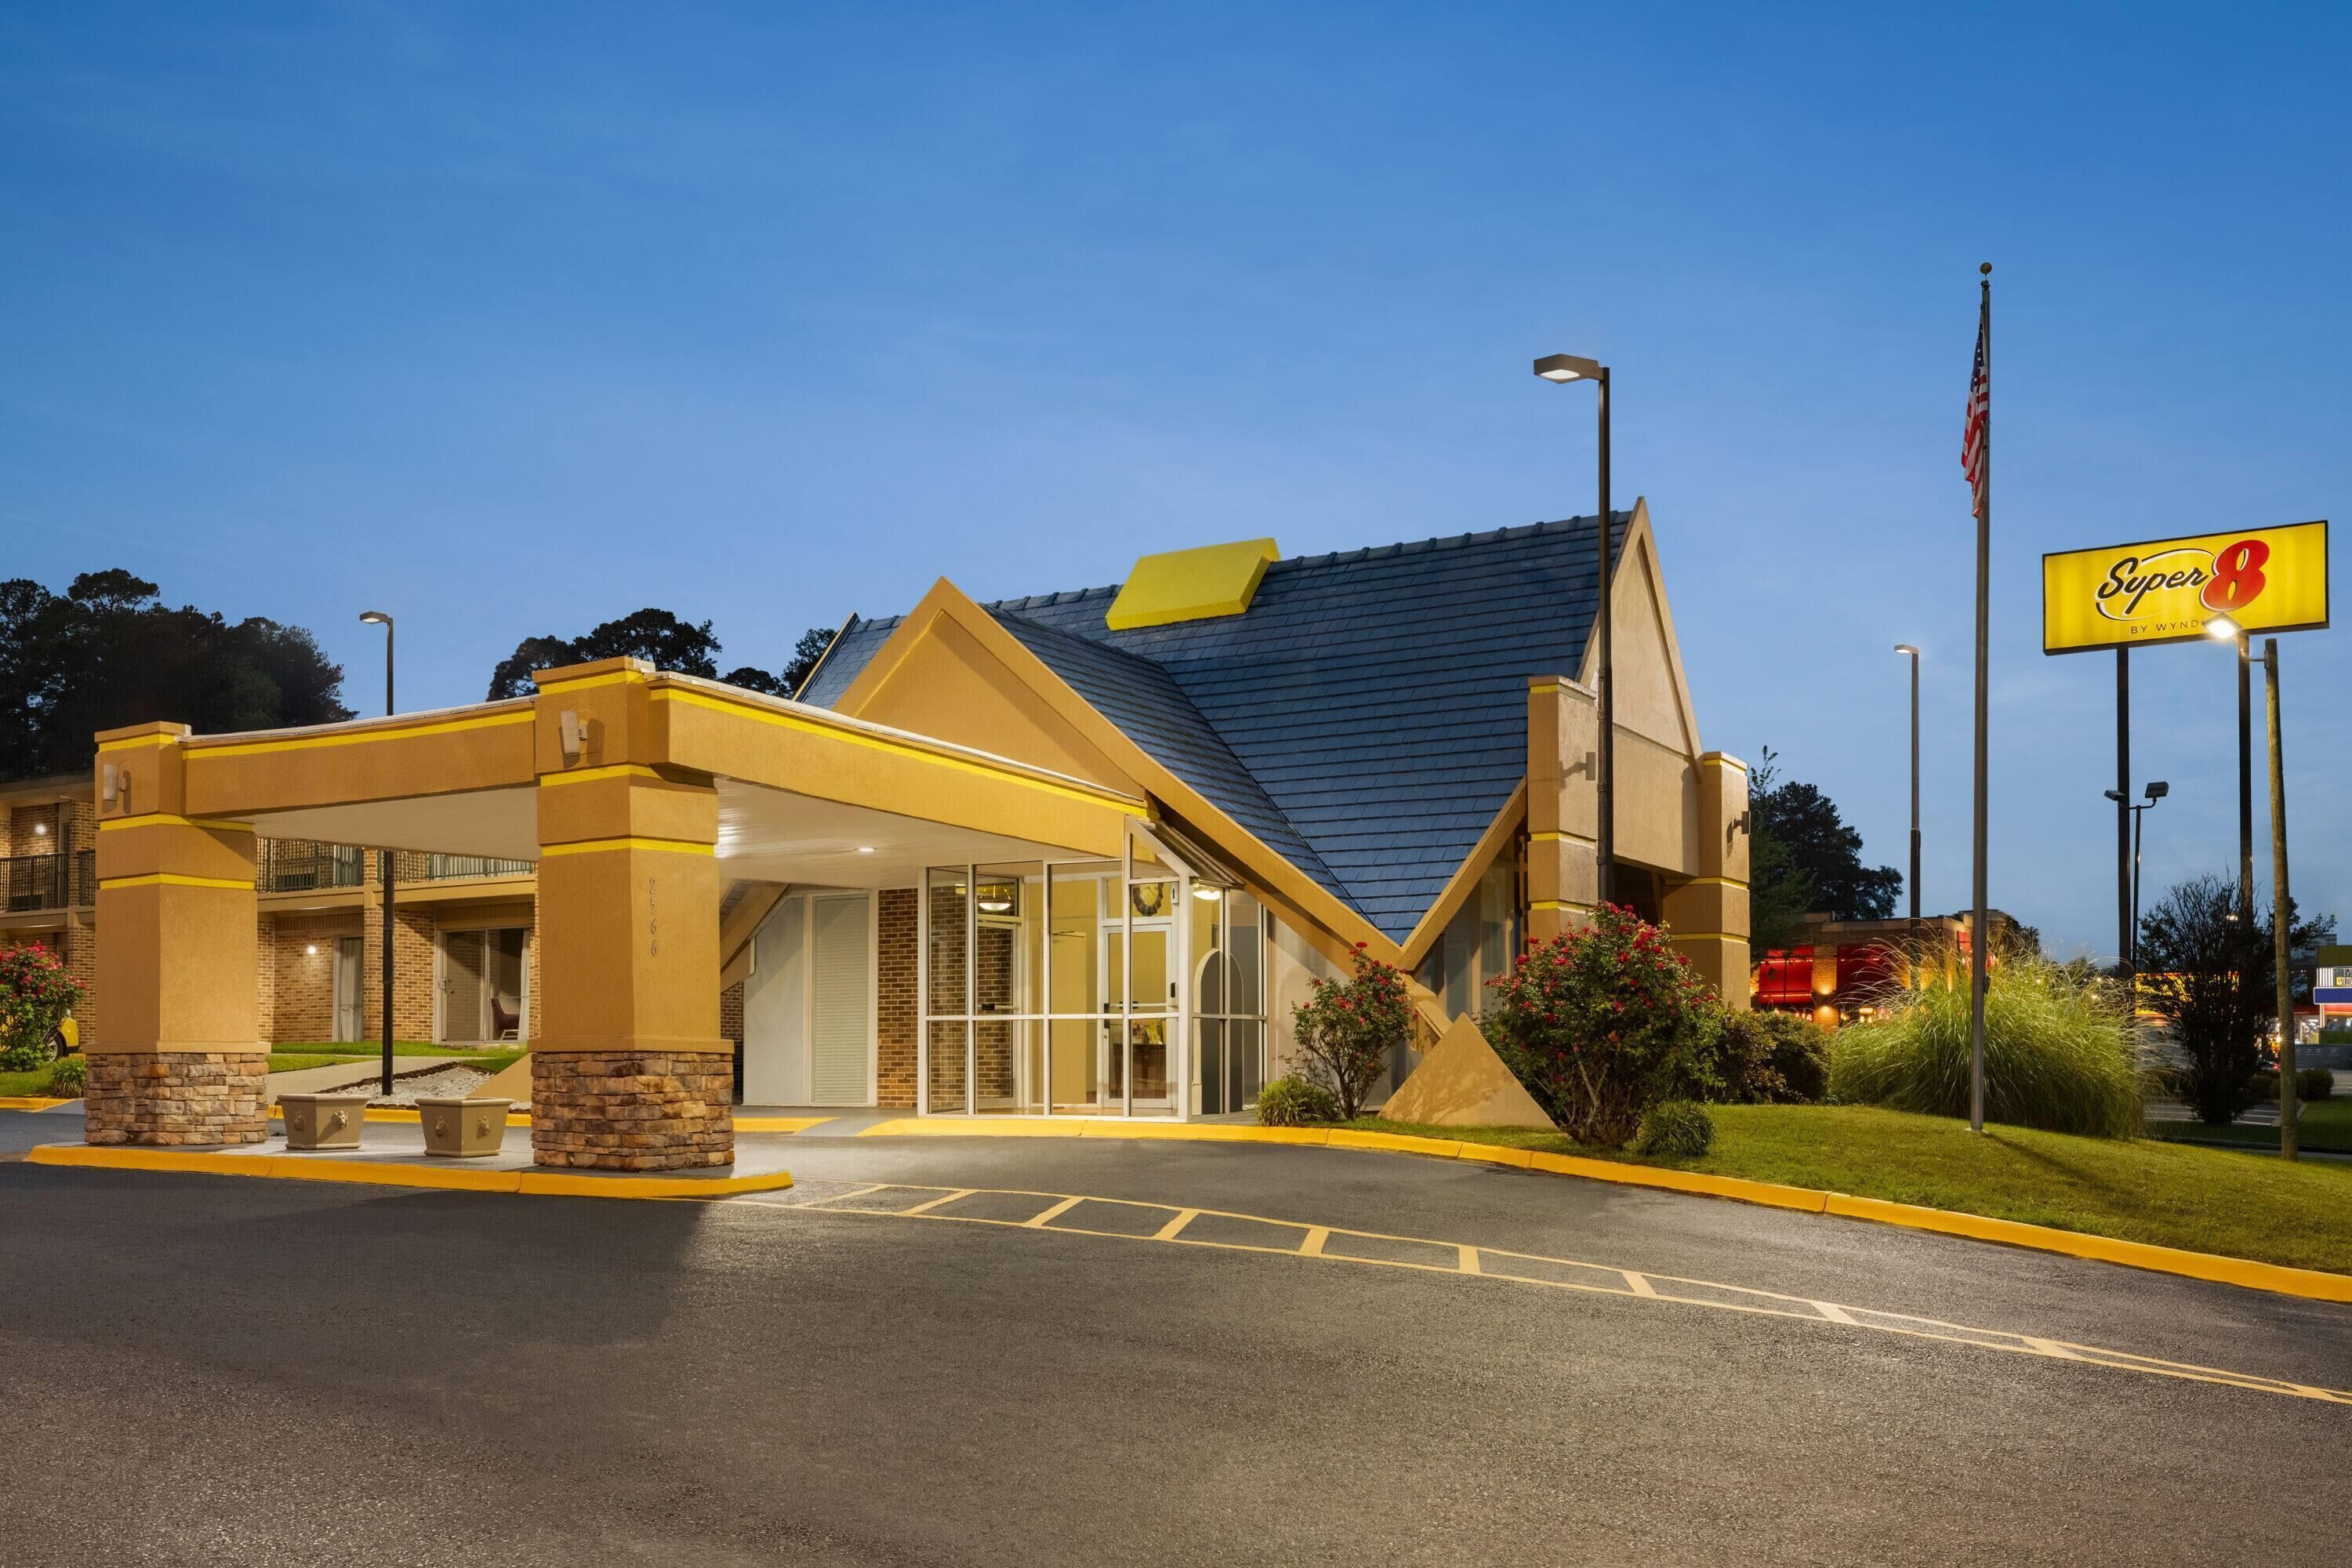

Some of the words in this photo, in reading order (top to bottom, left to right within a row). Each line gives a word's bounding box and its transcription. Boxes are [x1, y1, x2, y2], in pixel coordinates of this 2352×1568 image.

[2096, 557, 2209, 615] Super
[2199, 539, 2270, 612] 8
[2130, 625, 2147, 634] BY
[2155, 619, 2205, 632] WYND
